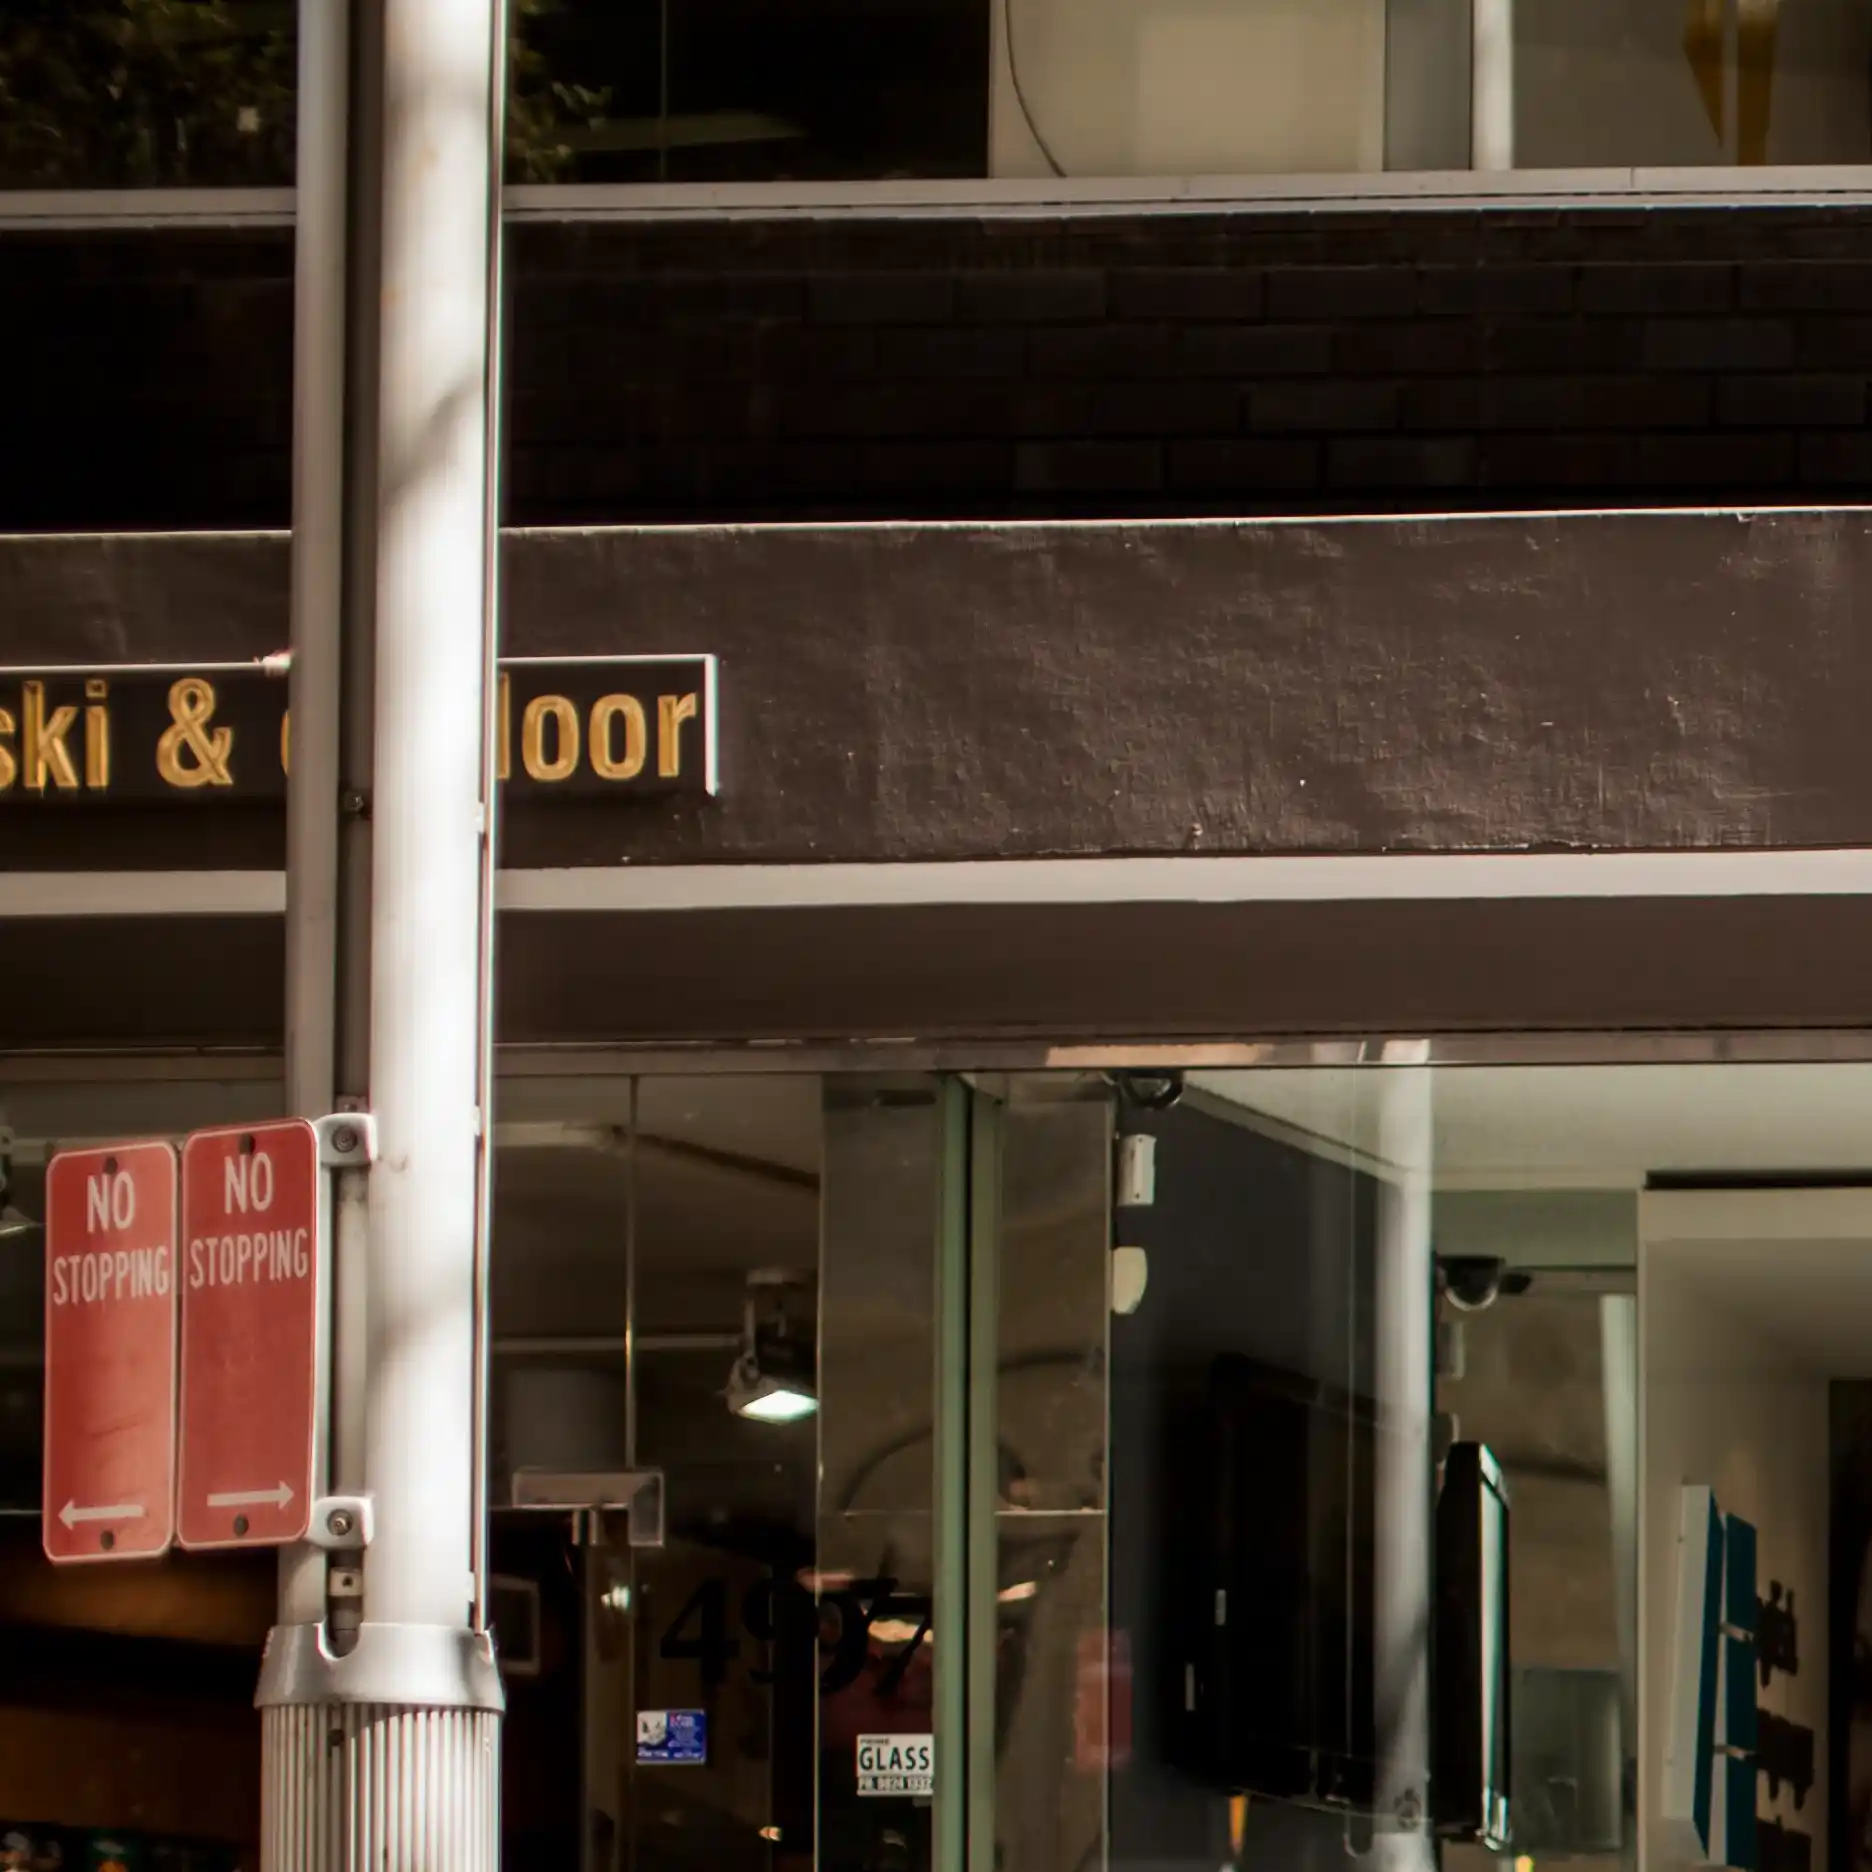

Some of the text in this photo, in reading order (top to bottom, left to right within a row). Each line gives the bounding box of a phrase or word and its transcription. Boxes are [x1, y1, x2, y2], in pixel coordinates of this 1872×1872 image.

[156, 678, 233, 787] &
[87, 1170, 135, 1233] NO
[224, 1150, 273, 1214] NO
[52, 1245, 170, 1307] STOPPING
[189, 1227, 309, 1290] STOPPING
[860, 1746, 929, 1771] GLASS
